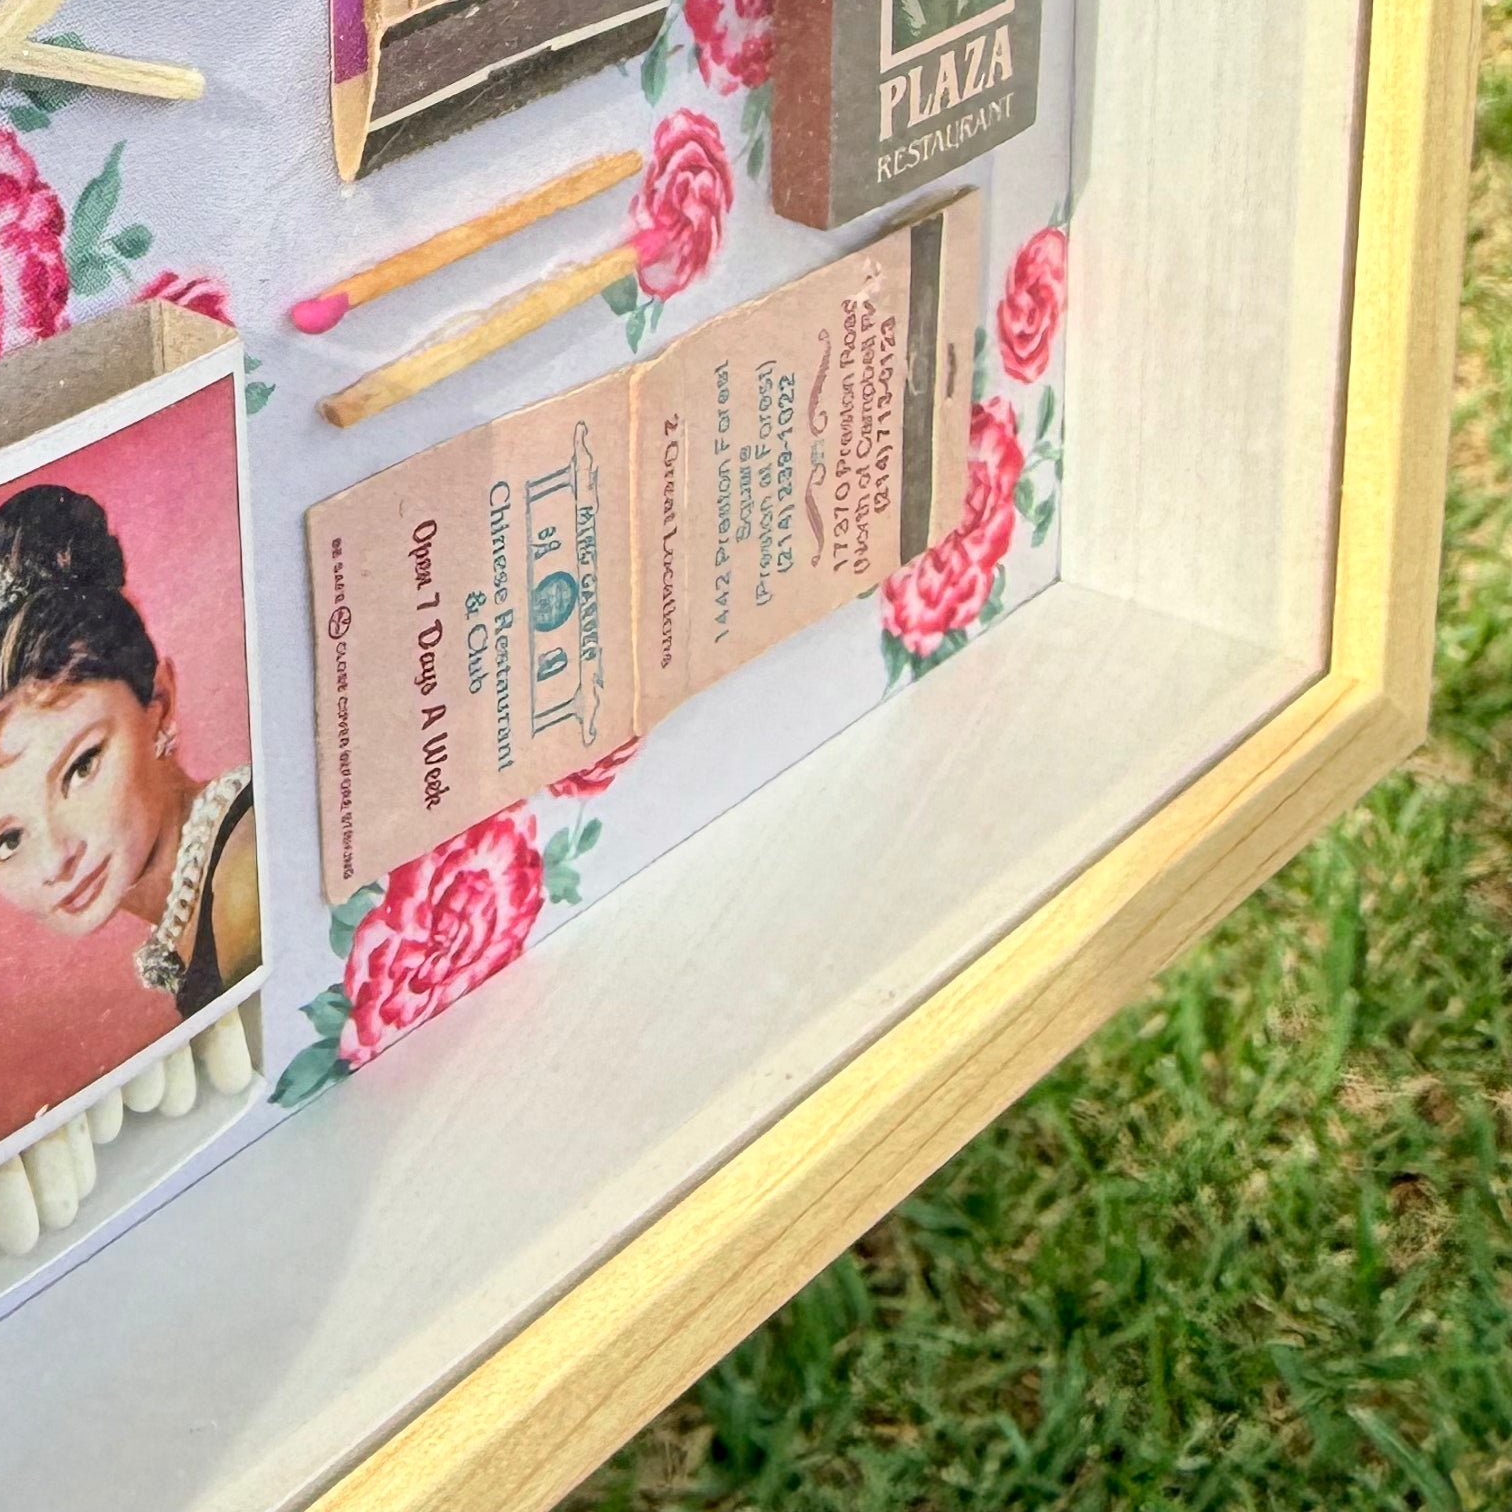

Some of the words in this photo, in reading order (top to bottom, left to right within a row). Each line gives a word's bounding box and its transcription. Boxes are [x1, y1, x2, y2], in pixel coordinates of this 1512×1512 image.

[878, 25, 1014, 143] PLAZA
[876, 92, 1015, 184] RESTAURANT
[714, 360, 731, 455] Forest
[408, 519, 439, 590] Open
[488, 481, 511, 603] Chinese
[415, 592, 440, 609] 7
[465, 590, 487, 620] &
[660, 527, 679, 668] Locations
[713, 571, 731, 643] 1442
[417, 620, 444, 696] Days
[467, 624, 489, 694] Club
[495, 609, 515, 772] Restaurant
[421, 705, 446, 727] A
[422, 733, 449, 811] Week
